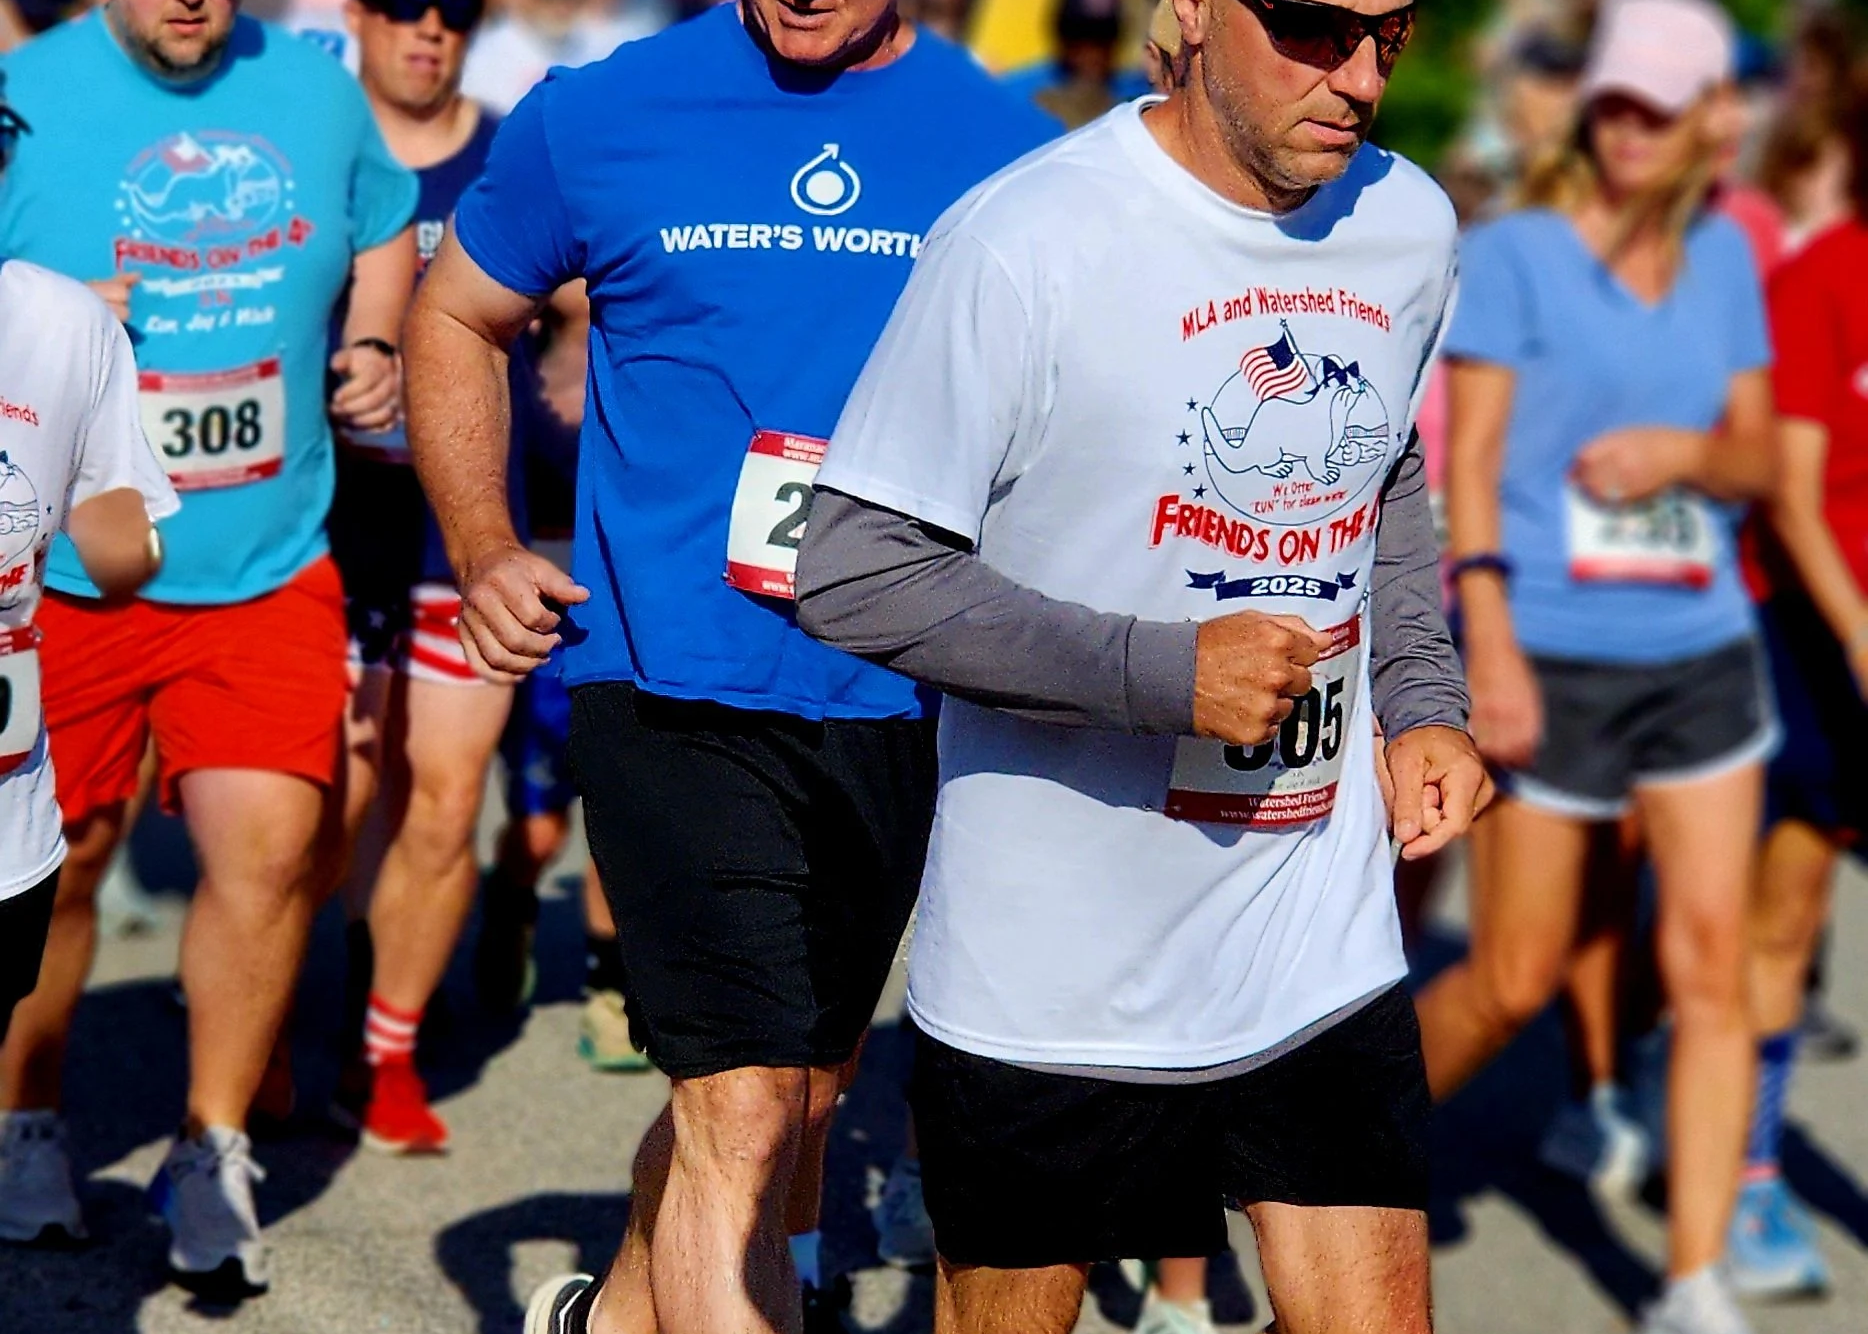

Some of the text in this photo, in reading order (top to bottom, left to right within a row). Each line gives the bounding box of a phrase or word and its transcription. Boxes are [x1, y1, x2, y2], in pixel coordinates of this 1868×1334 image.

[660, 224, 803, 253] WATER'S
[1182, 286, 1391, 342] MLA and Watershed Friends
[161, 397, 263, 459] 308
[1150, 494, 1272, 563] FRIENDS
[1277, 526, 1321, 566] ON
[1328, 503, 1368, 555] THE
[1250, 577, 1322, 597] 2025
